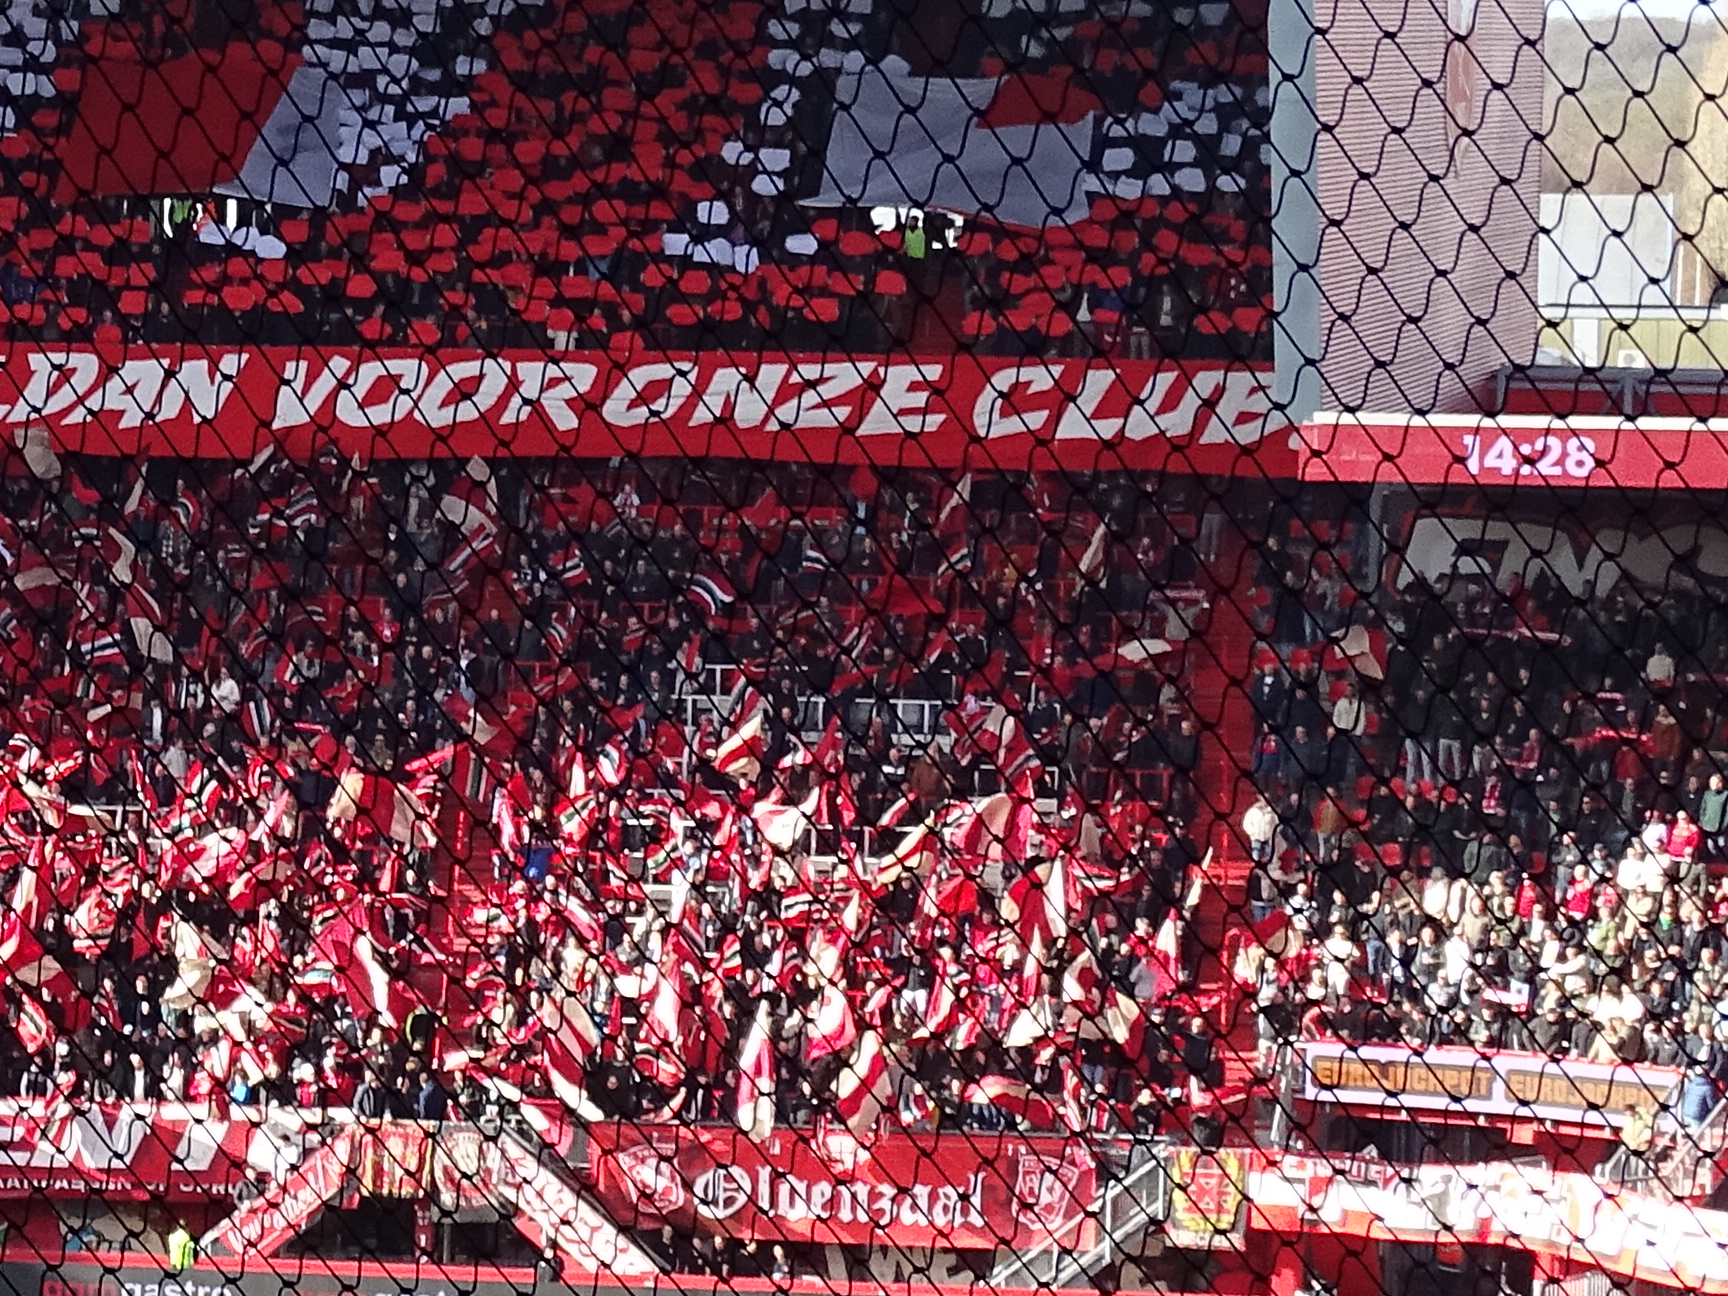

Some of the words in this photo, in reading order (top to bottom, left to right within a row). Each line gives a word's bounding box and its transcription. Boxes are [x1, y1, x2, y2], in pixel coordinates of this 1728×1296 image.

[271, 356, 597, 430] VOOR
[604, 361, 948, 435] ONZE
[1463, 434, 1597, 479] 14:28
